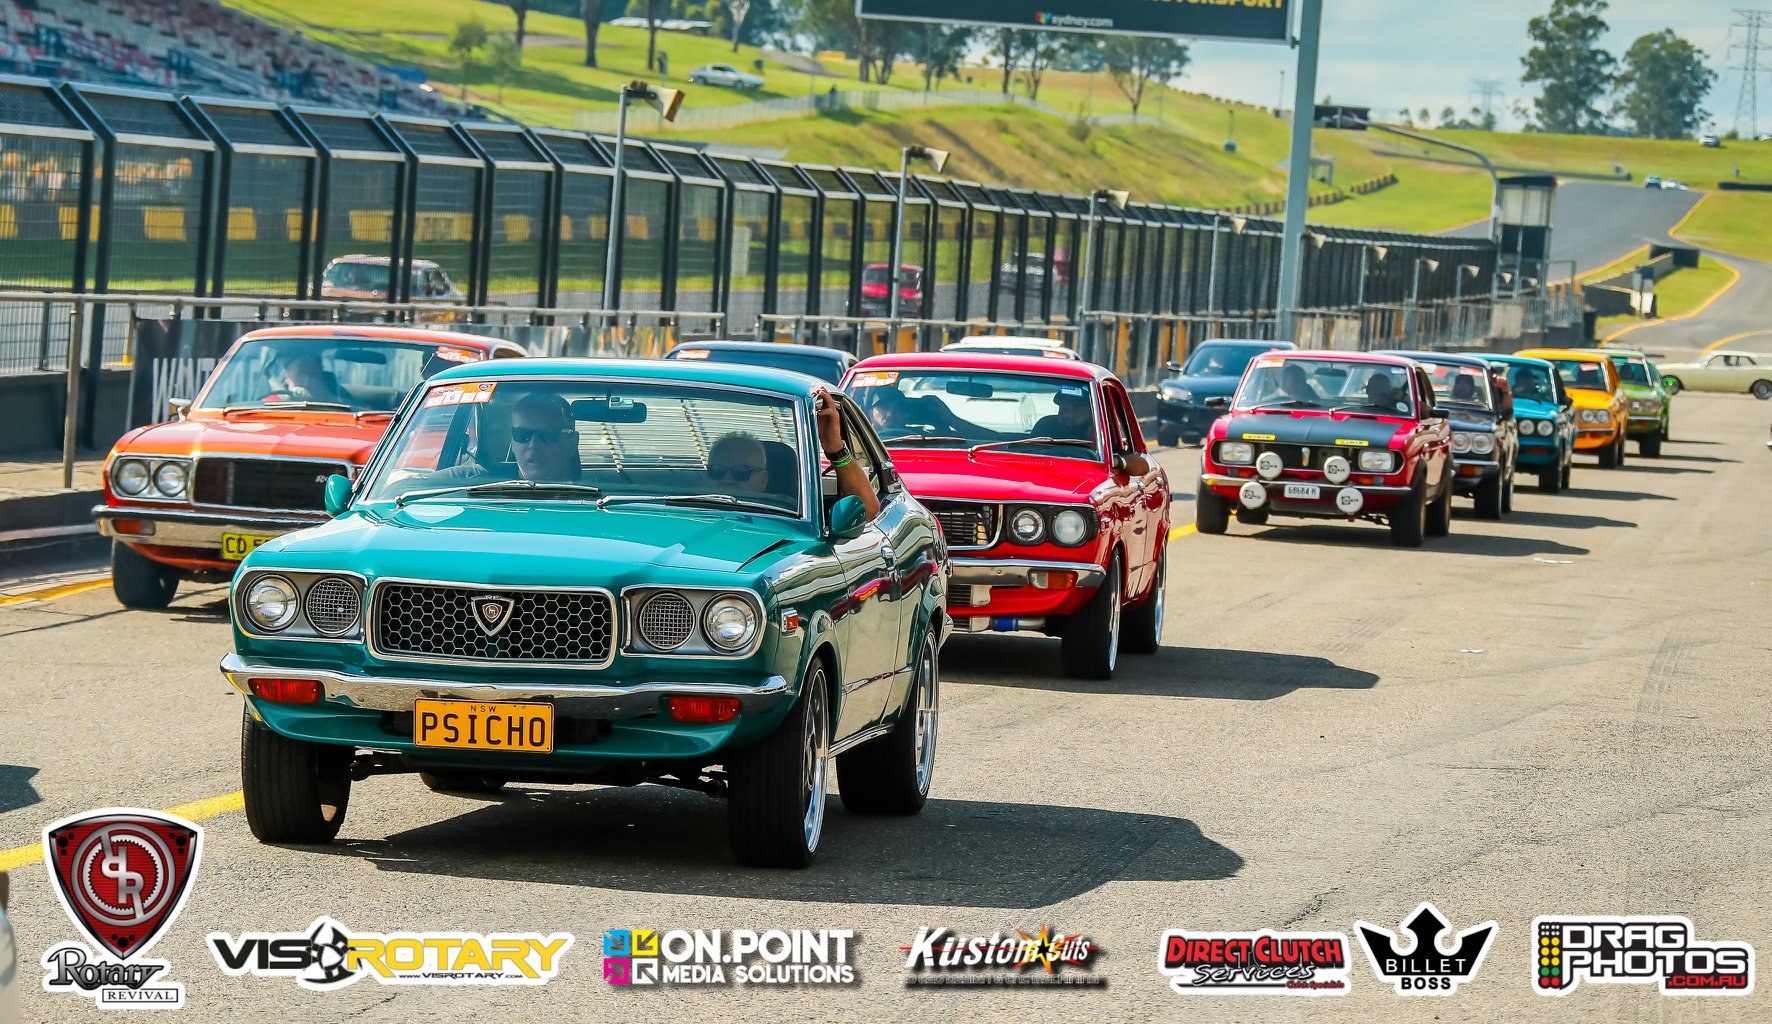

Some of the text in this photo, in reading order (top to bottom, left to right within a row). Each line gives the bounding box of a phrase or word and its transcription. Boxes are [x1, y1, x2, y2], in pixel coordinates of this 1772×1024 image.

[1052, 15, 1113, 28] sydney.com
[470, 705, 497, 713] NSW
[421, 712, 546, 747] PSICHO
